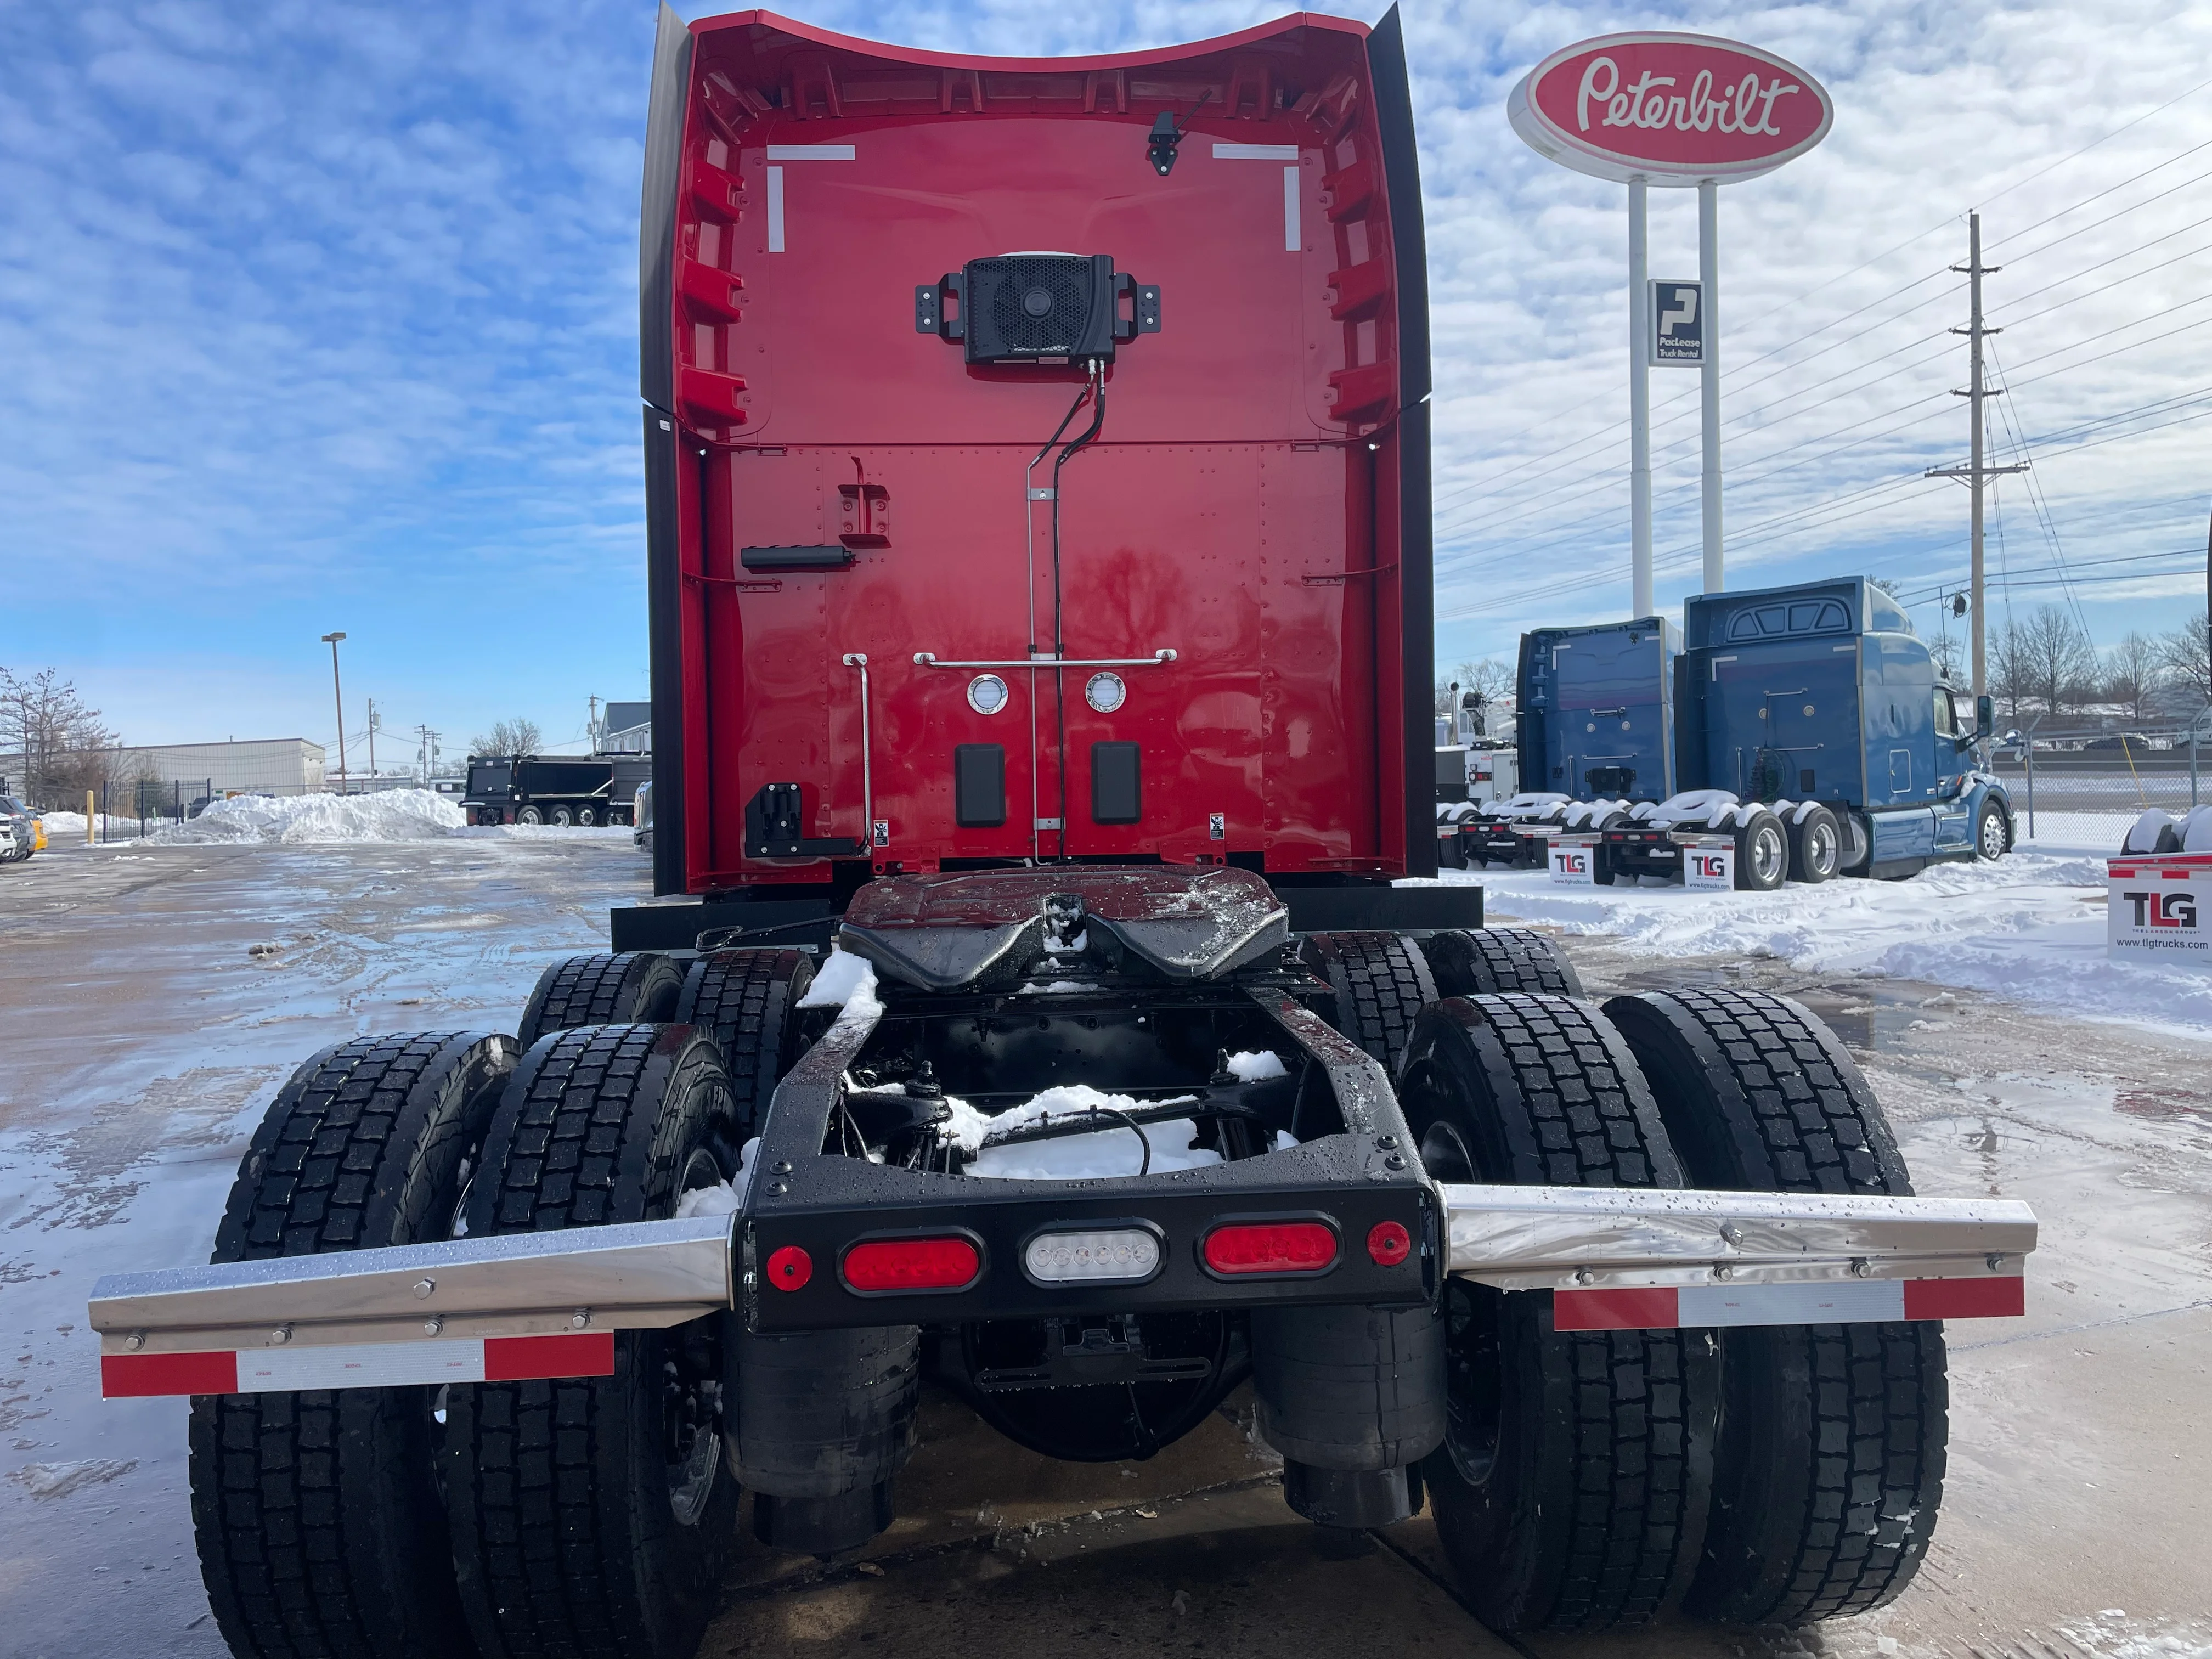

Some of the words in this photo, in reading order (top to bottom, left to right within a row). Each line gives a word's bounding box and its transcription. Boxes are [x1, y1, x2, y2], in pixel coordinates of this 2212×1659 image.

[1577, 57, 1799, 136] Peterbilt
[1659, 336, 1701, 347] PacLease
[1660, 349, 1677, 357] Truck
[1677, 349, 1699, 358] Rental
[1555, 854, 1586, 873] TLG
[1691, 856, 1725, 877] TLG
[2124, 892, 2197, 927] TLG
[2117, 939, 2208, 950] www.tlgtrucks.com
